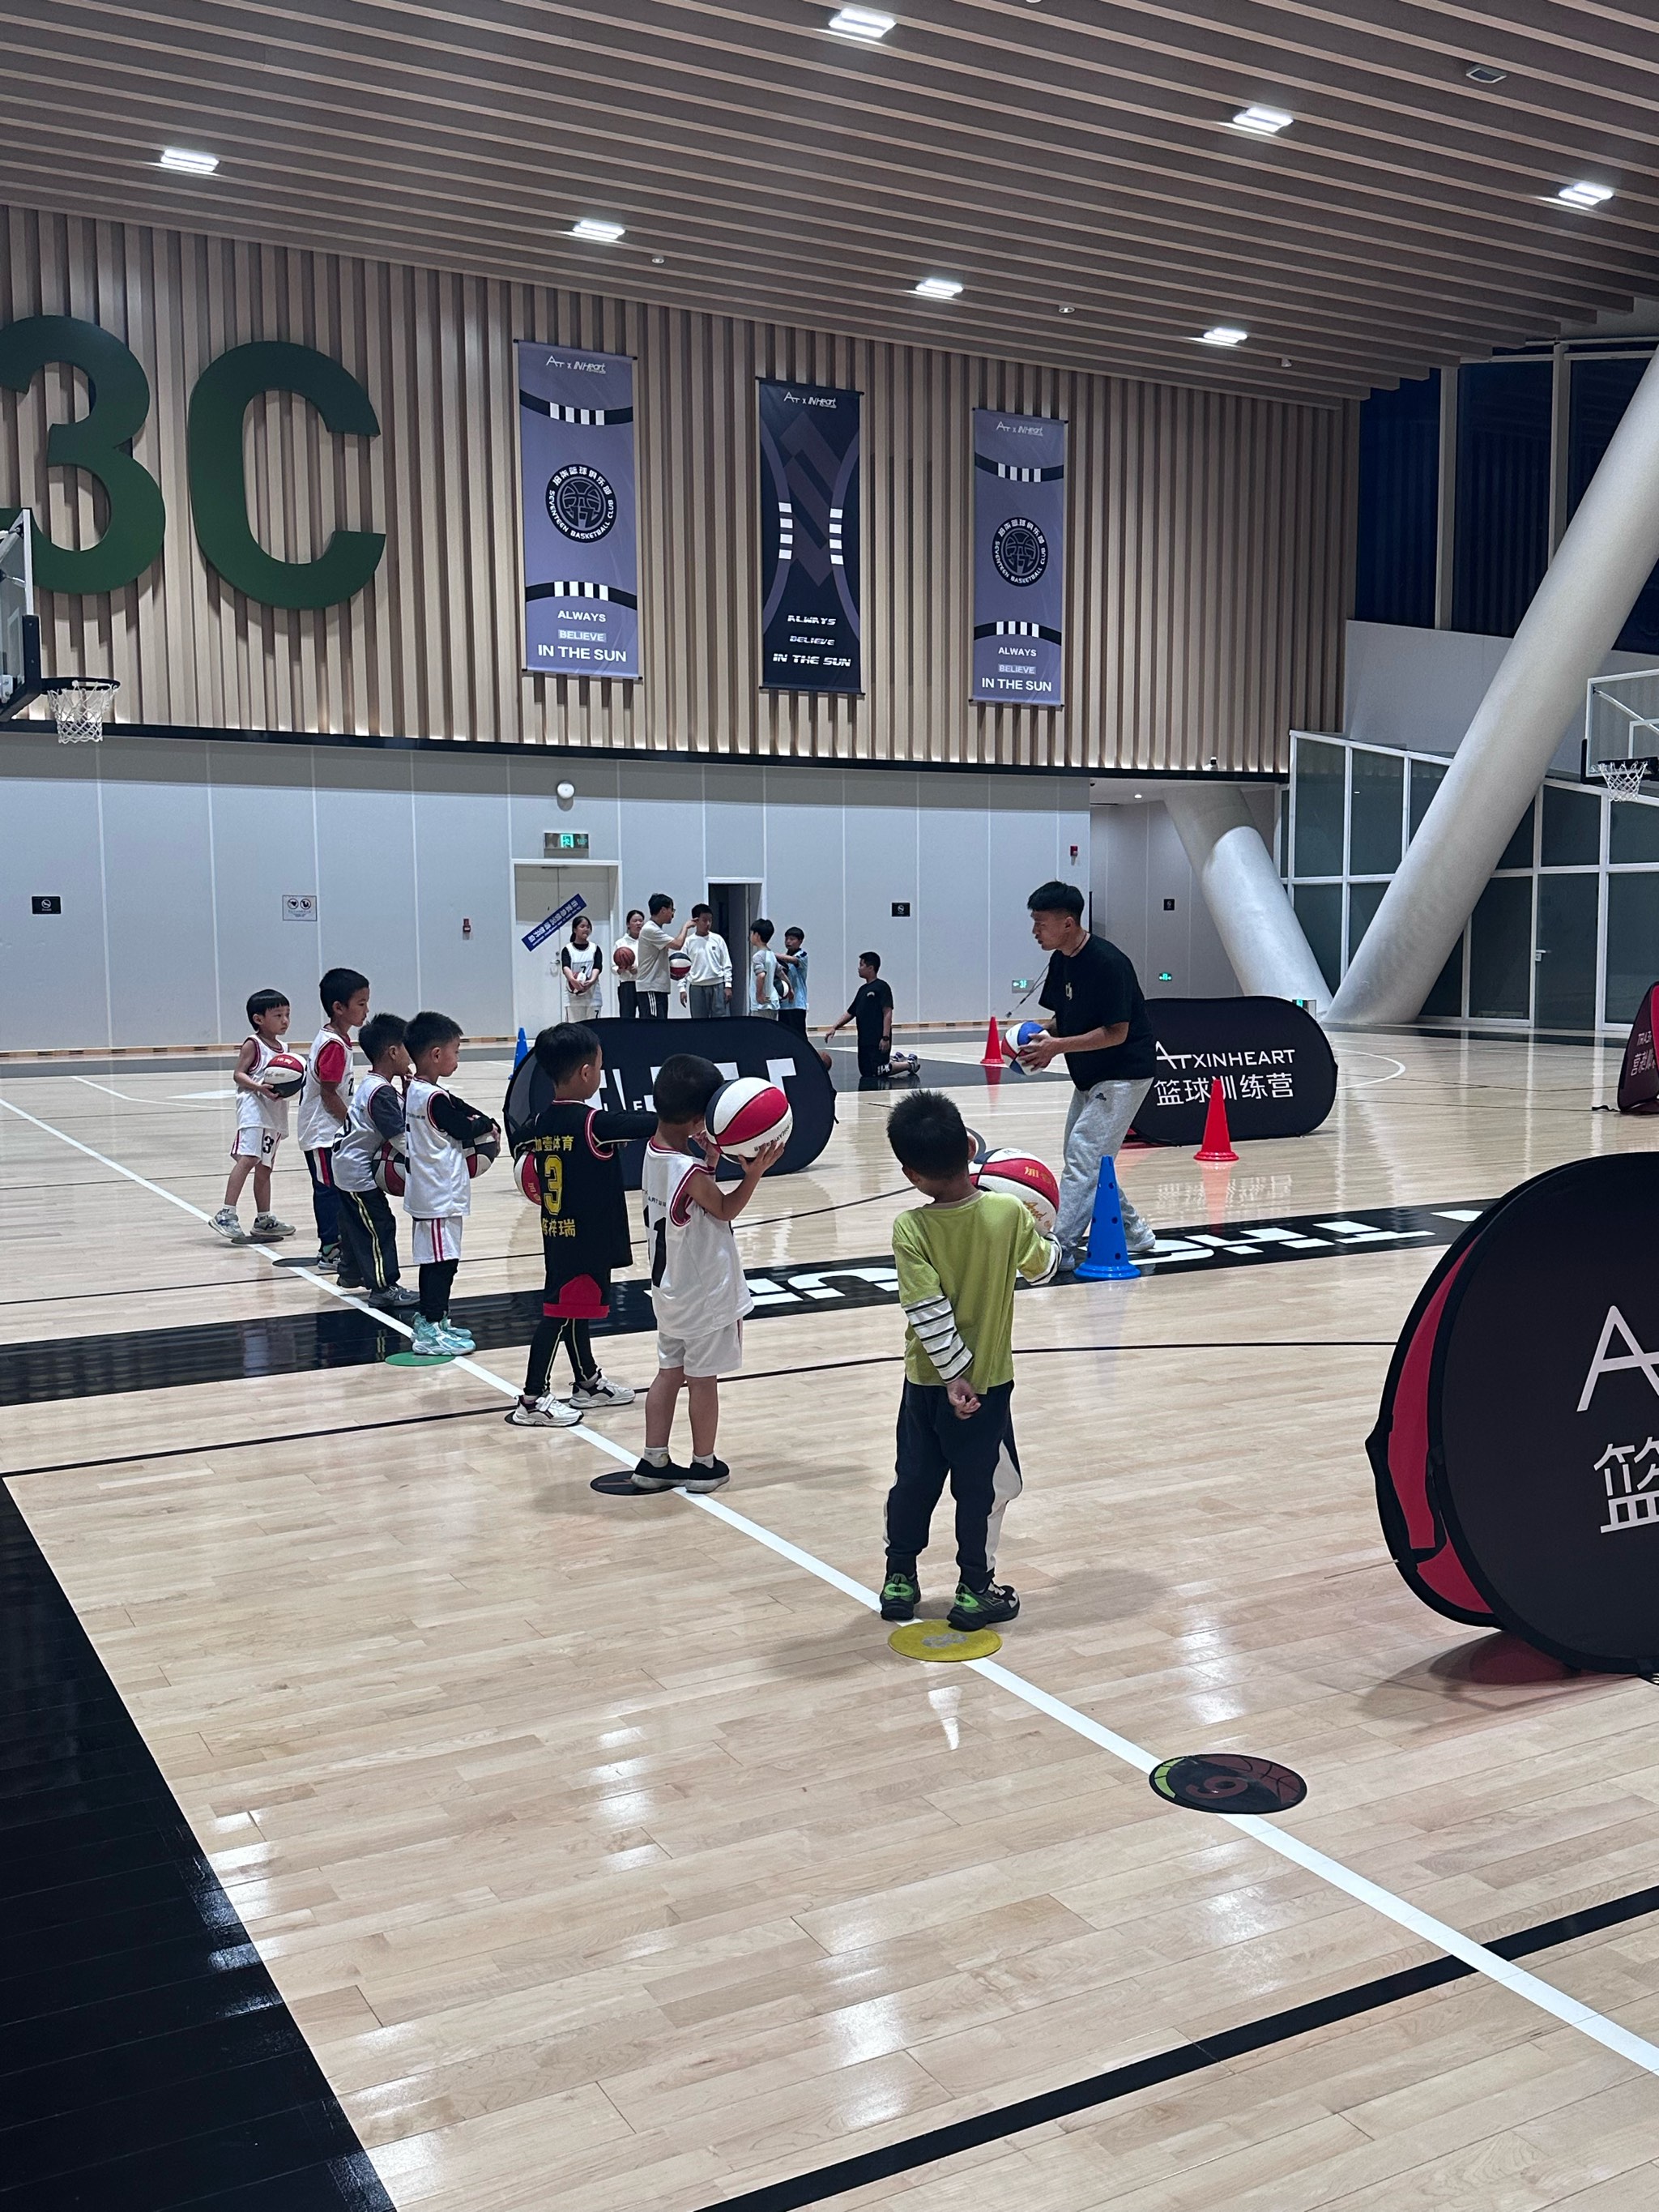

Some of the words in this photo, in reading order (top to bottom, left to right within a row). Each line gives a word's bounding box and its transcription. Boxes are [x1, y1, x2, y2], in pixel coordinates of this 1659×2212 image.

[548, 489, 569, 532] SEVENTEEN
[570, 522, 610, 540] BASKETBALL
[1010, 567, 1043, 583] BASKETBALL
[557, 610, 606, 622] ALWAYS
[787, 615, 837, 626] ALWAYS
[559, 630, 604, 642] BELIEVE
[789, 635, 835, 646] BELIEVE
[538, 644, 554, 657] IN
[557, 646, 591, 660] THE
[594, 648, 627, 662] SUN
[773, 652, 788, 662] IN
[792, 655, 820, 664] THE
[822, 657, 851, 667] SUN
[998, 647, 1037, 657] ALWAYS
[999, 664, 1035, 674] BELIEVE
[982, 677, 995, 688] IN
[997, 678, 1023, 690] THE
[1026, 681, 1052, 692] SUN
[262, 1135, 275, 1154] 3
[535, 1134, 574, 1151] 加壹体育
[543, 1154, 563, 1215] 3
